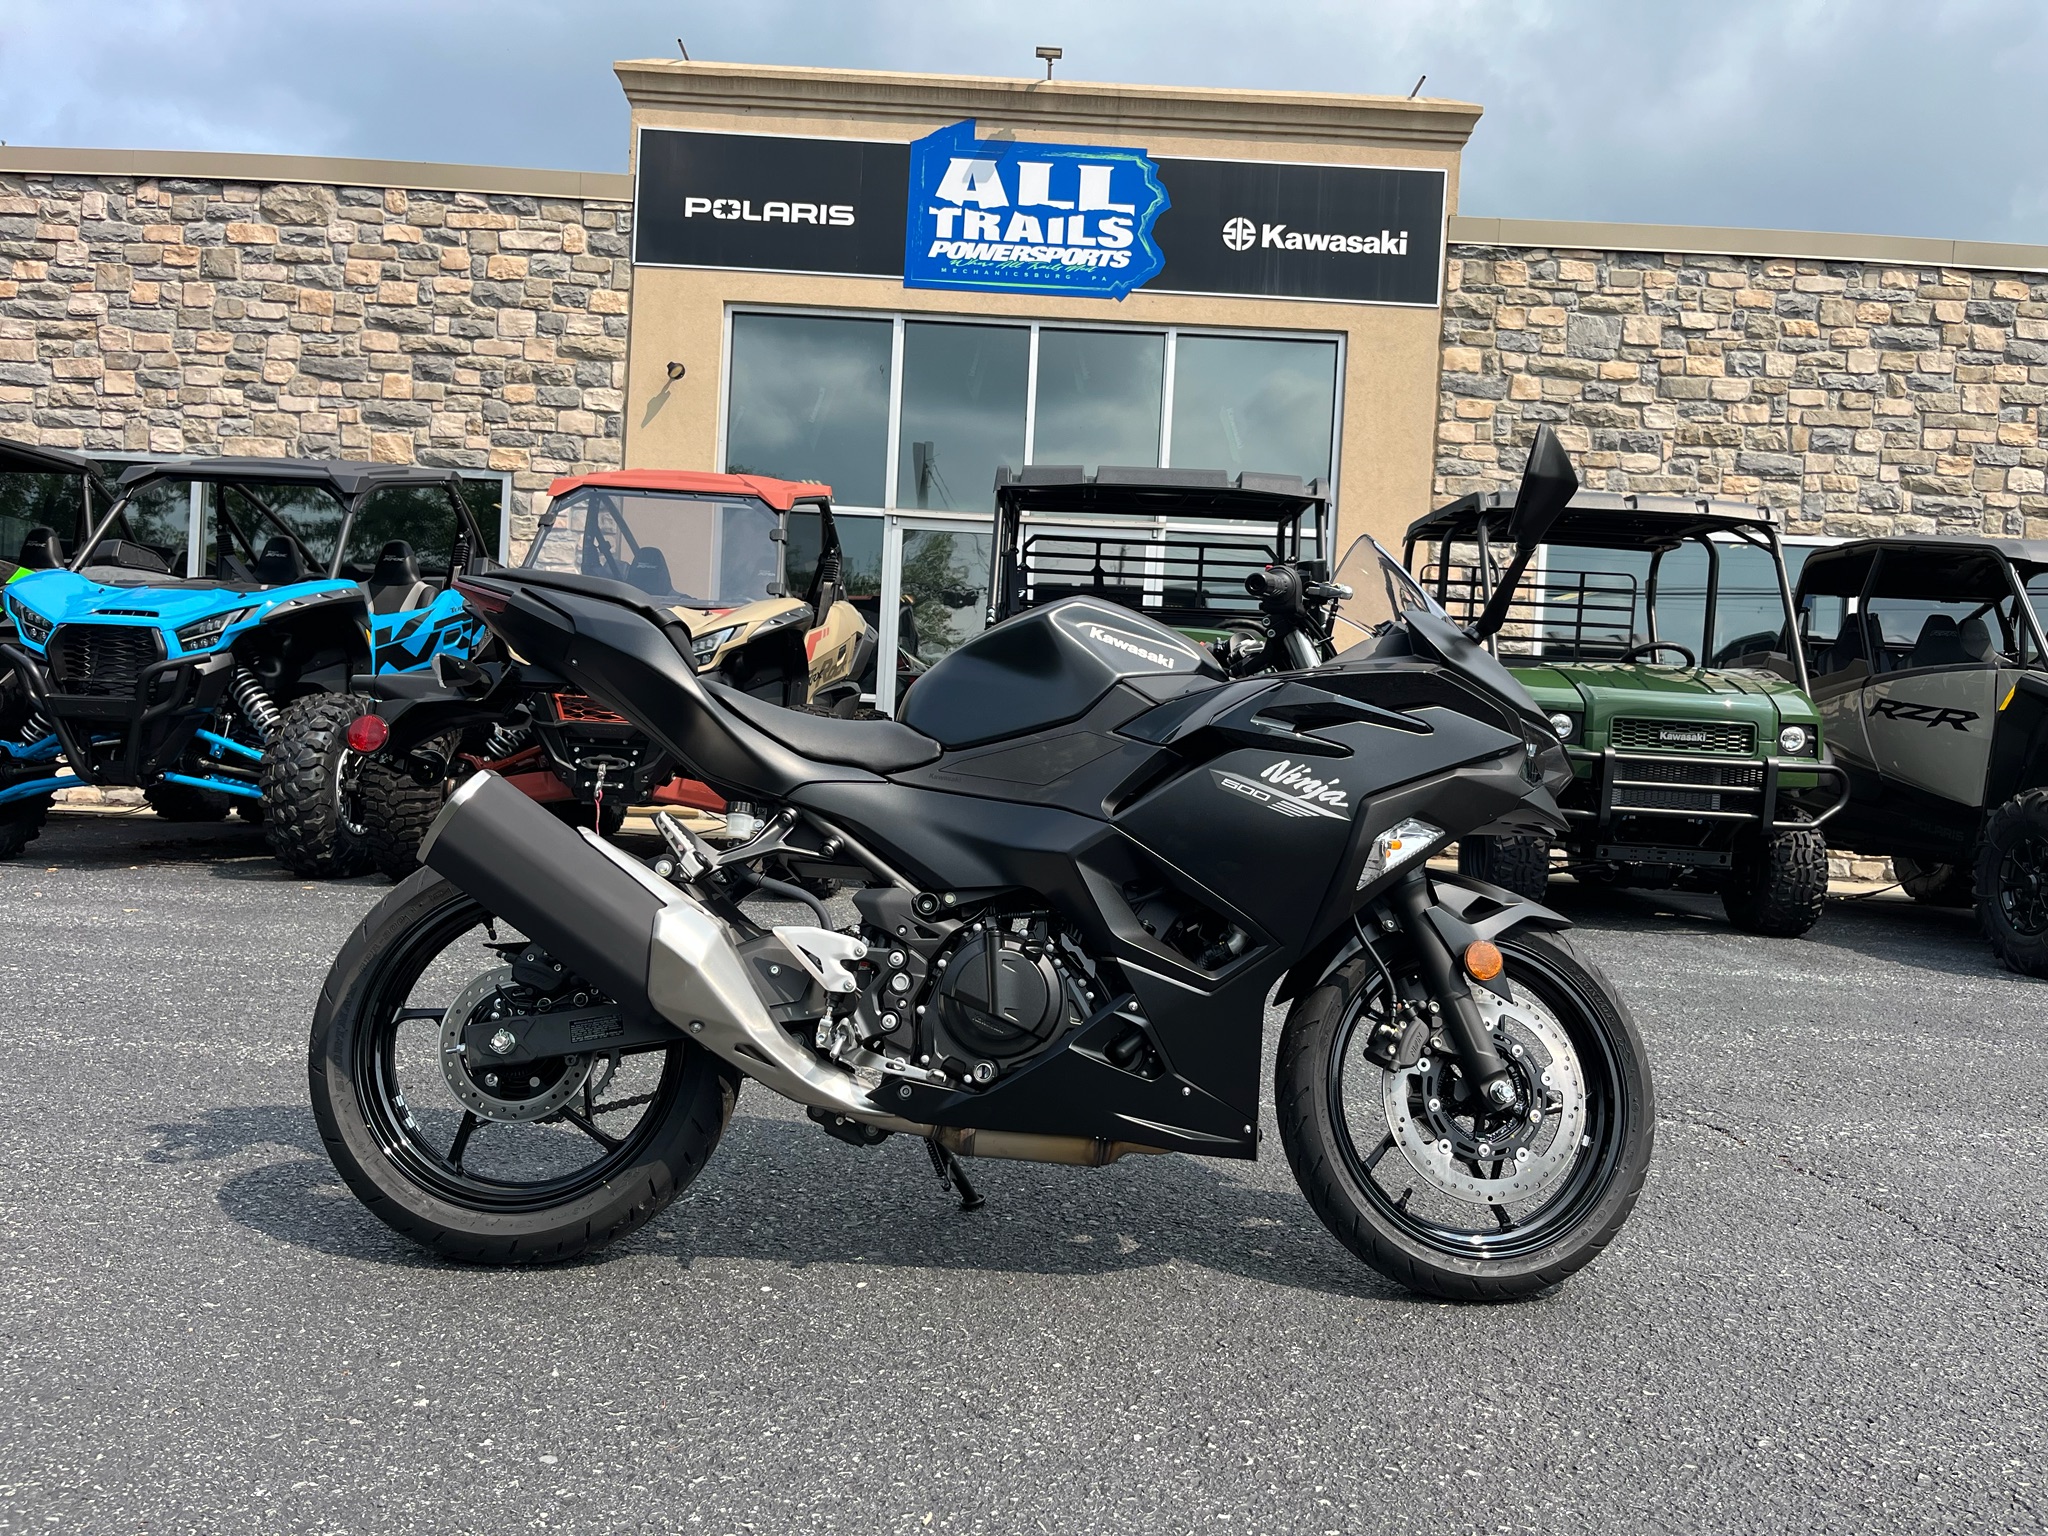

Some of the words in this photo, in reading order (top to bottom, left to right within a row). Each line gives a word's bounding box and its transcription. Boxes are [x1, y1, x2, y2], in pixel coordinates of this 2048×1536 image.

[934, 157, 1136, 217] ALL
[684, 196, 856, 226] POLARIS
[928, 206, 1134, 249] TRAILS
[927, 240, 1133, 269] POWERSPORTS
[1261, 223, 1409, 256] Kawasaki
[1089, 626, 1175, 670] Kawasaki
[1867, 697, 1981, 733] RZR
[1659, 731, 1707, 742] Kawasaki
[1220, 777, 1272, 802] 500
[1260, 759, 1349, 808] Ninja
